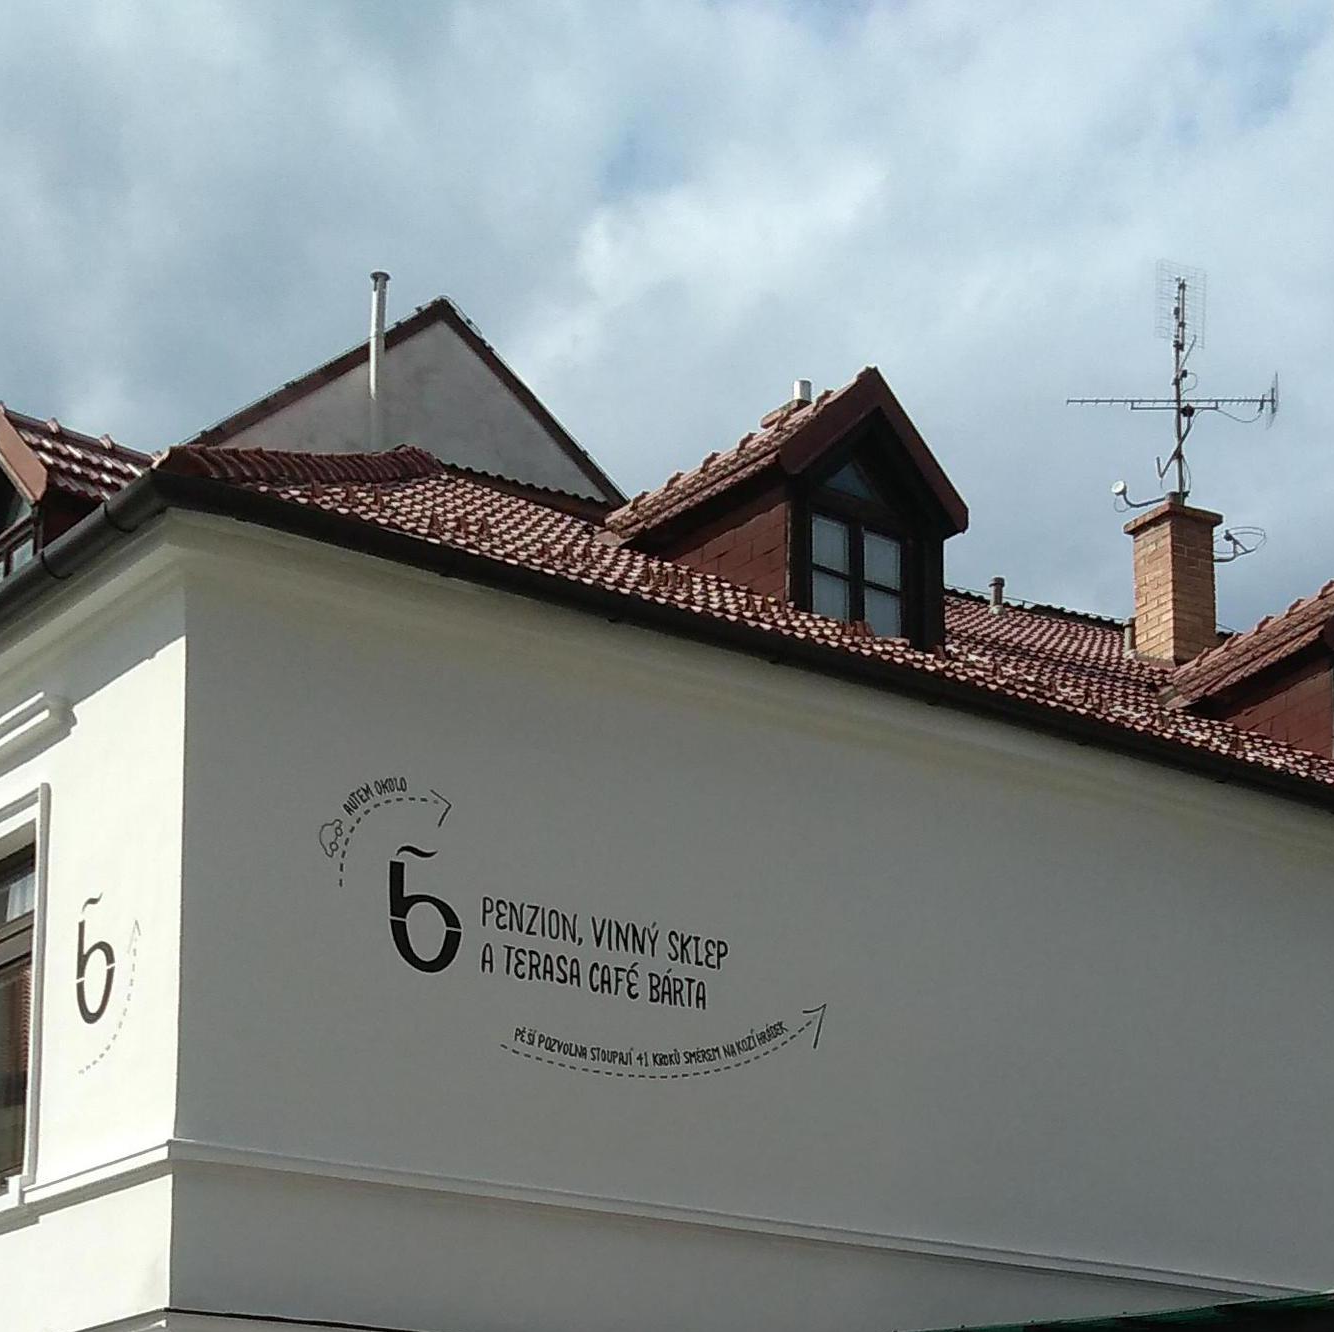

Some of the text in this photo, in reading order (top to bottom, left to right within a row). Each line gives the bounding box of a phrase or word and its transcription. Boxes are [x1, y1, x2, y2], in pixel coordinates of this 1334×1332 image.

[342, 776, 408, 816] AUTEM OKOLO
[481, 896, 729, 970] PENZION, VINNÝ SKLEP
[481, 942, 707, 1010] A TERASA CAFÉ BÁRTA
[537, 1033, 588, 1061] POZVOLNA
[590, 1047, 634, 1067] STOUPAJÍ
[636, 1052, 649, 1068] 41
[722, 1043, 738, 1059] NA
